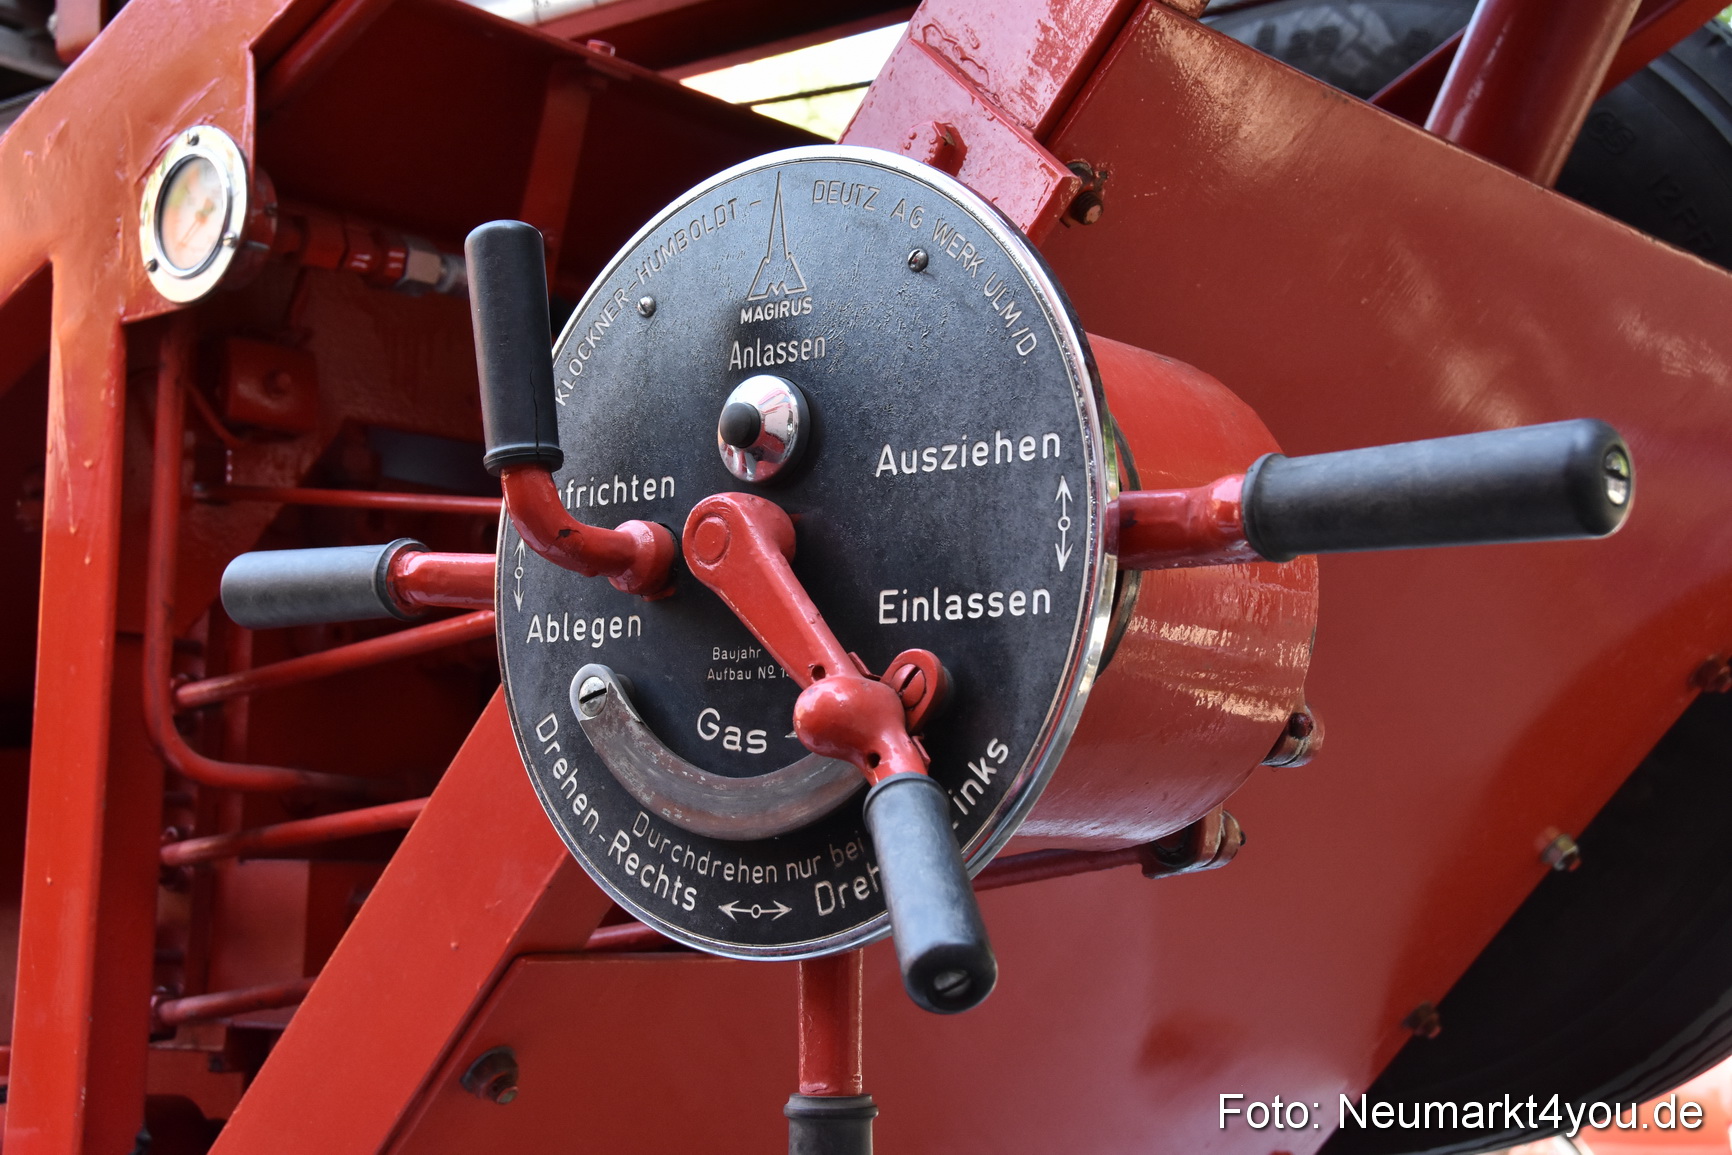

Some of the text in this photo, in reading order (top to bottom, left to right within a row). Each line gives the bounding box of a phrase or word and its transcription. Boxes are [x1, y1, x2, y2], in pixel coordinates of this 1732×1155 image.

[813, 179, 881, 211] DEUTZ
[890, 198, 925, 229] AG
[932, 218, 985, 279] WERK
[740, 296, 813, 325] MAGIRUS
[728, 337, 826, 371] Anlassen
[875, 430, 1061, 478] Ausziehen
[557, 474, 675, 510] frichten
[878, 586, 1051, 625] Einlassen
[526, 612, 641, 648] Ablegen
[712, 645, 761, 663] Baujahr
[707, 667, 752, 681] Aufbau
[696, 707, 768, 754] Gas
[632, 810, 865, 884] Durchdrehen nur bei
